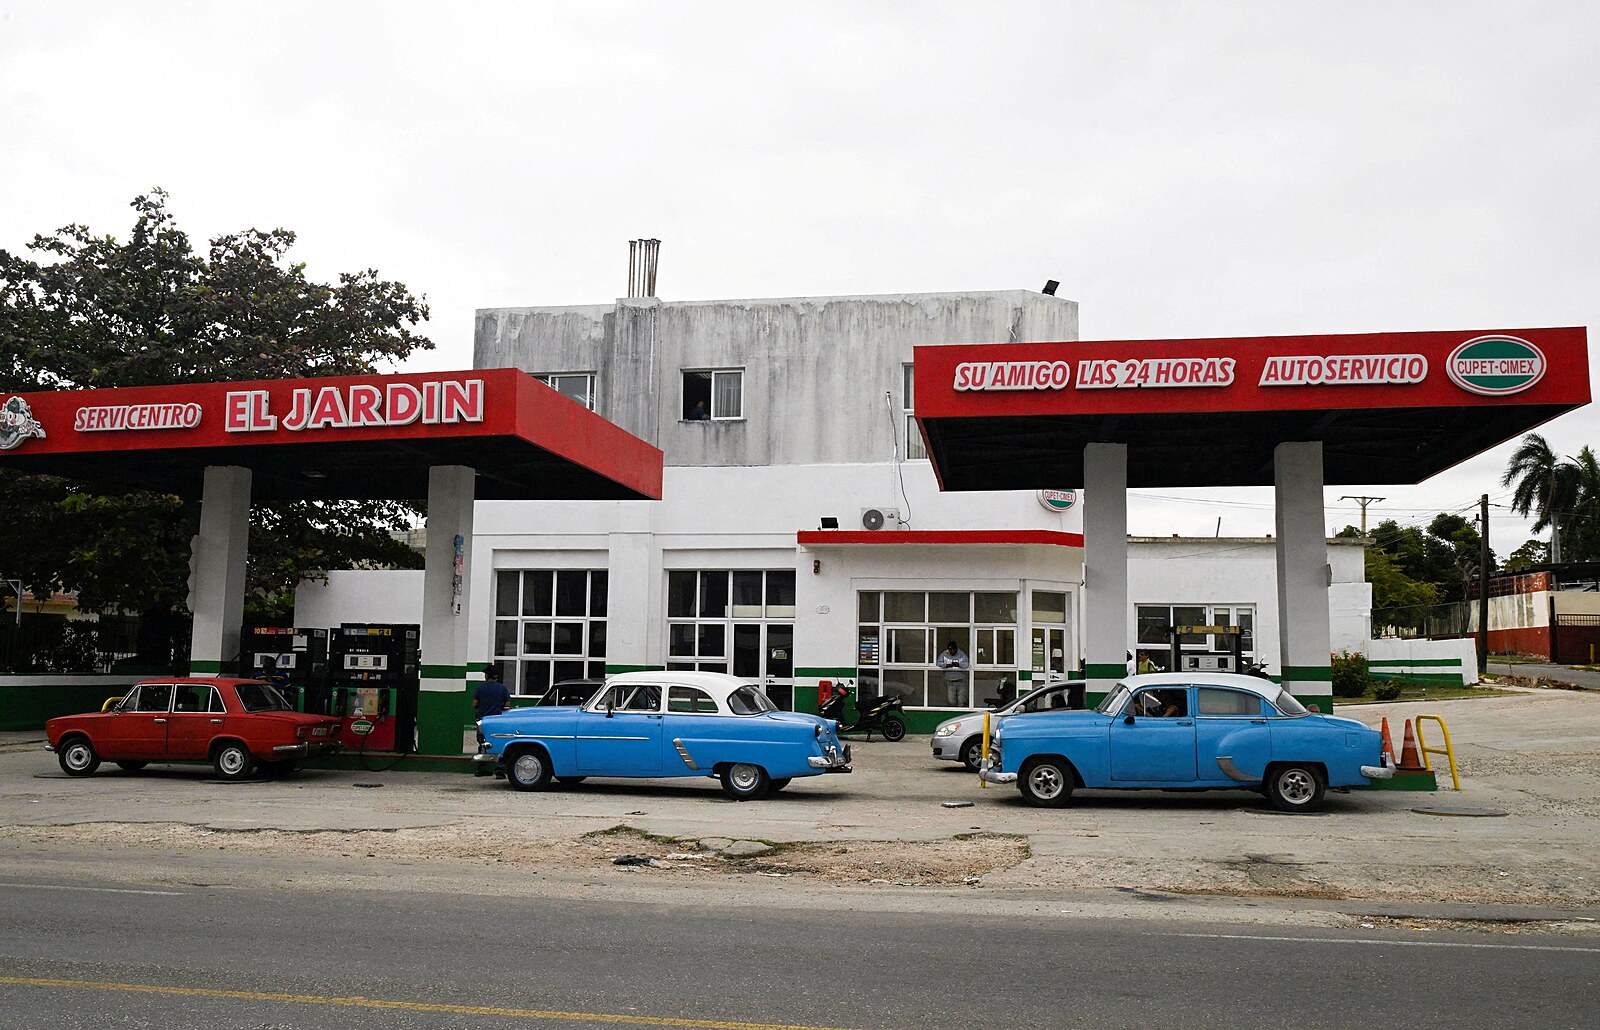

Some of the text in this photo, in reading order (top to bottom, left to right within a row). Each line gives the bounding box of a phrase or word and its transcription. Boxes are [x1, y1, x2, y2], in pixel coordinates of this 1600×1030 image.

[955, 362, 1069, 389] SU AMIGO
[1076, 359, 1235, 387] LAS 24 HORAS
[1262, 355, 1427, 384] AUTOSERVICIO
[1456, 358, 1536, 375] CUPET-CIMEX
[75, 403, 201, 431] SERVICENTRO
[225, 379, 484, 432] EL JARDIN
[1044, 490, 1074, 501] CUPET-CIMEX
[354, 698, 360, 707] 6
